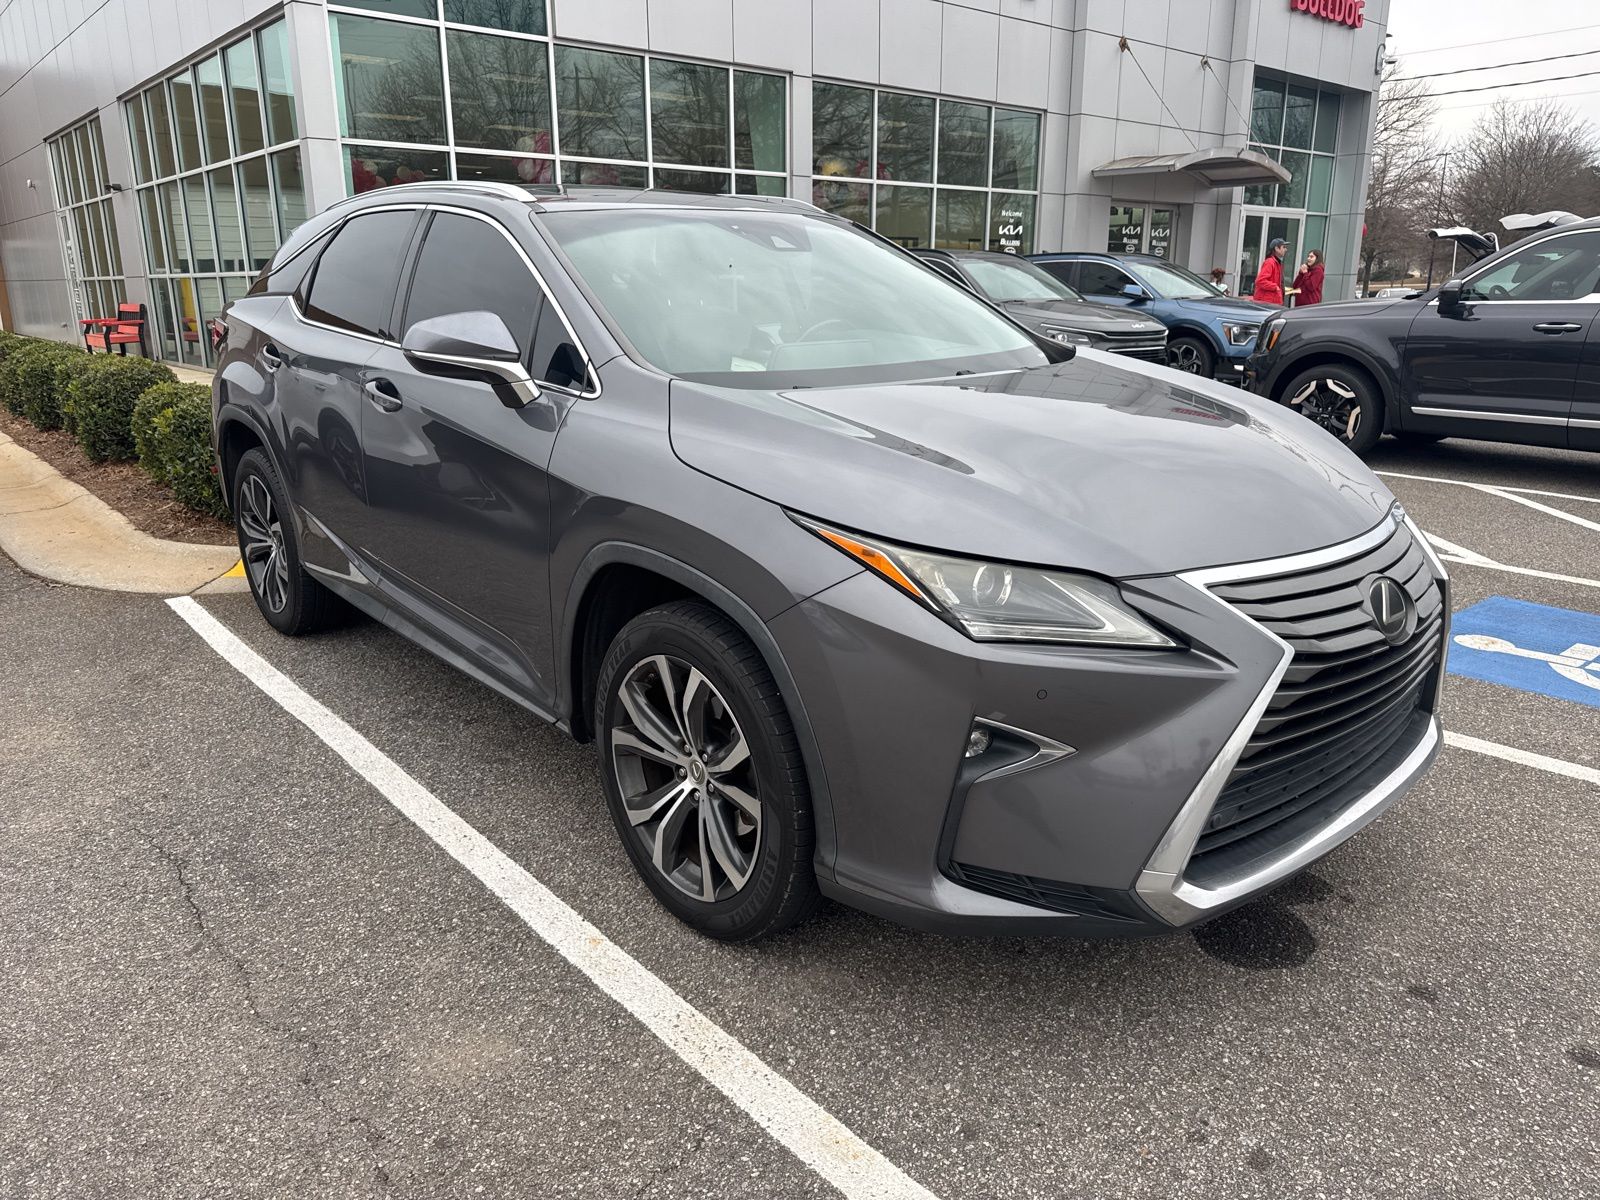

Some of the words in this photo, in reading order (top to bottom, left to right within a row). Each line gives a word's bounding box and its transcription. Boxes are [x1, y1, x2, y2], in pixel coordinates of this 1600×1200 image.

[1001, 209, 1023, 217] Welcome
[998, 225, 1023, 235] KIA
[1122, 226, 1141, 235] KIA
[1151, 228, 1170, 237] KIA
